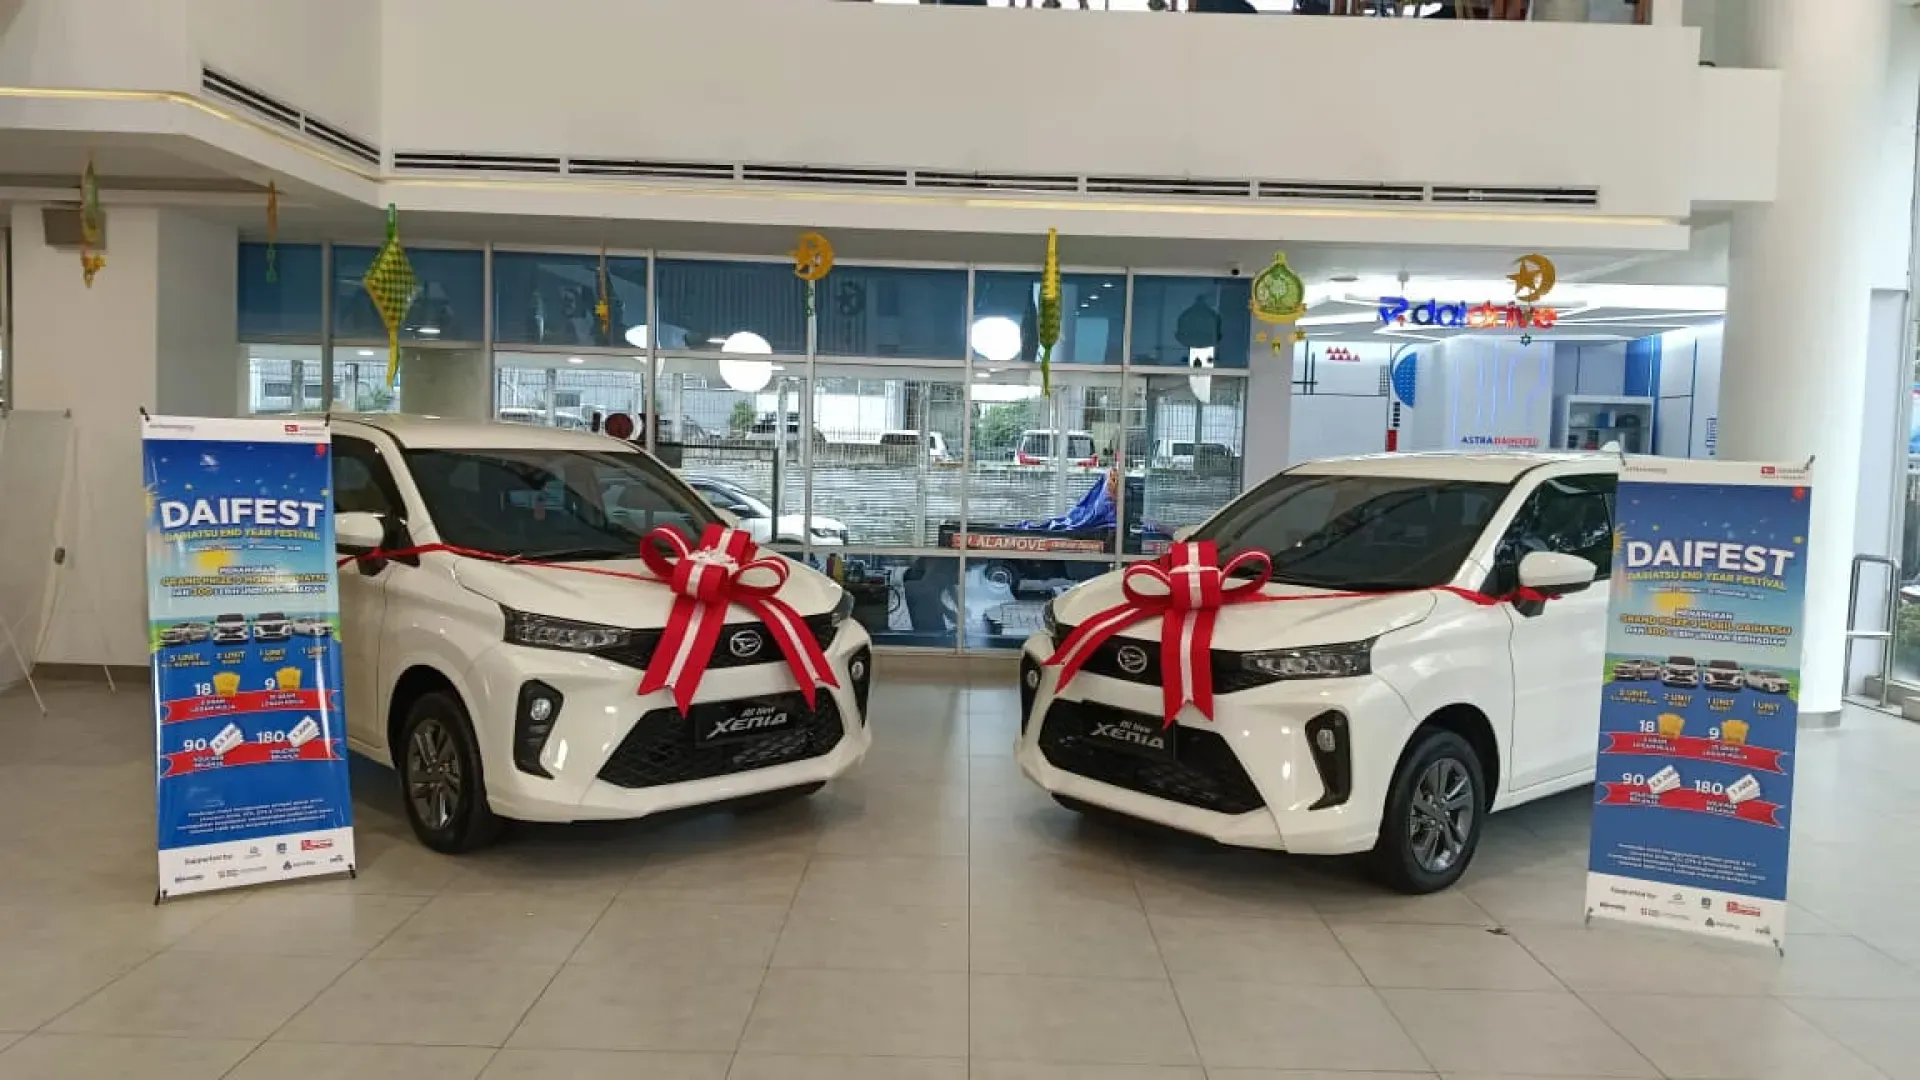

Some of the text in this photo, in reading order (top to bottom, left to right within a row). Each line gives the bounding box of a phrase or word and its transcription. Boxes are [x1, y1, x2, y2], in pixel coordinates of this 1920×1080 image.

[1411, 297, 1558, 329] daidrive
[160, 499, 324, 529] DAIFEST
[220, 528, 241, 537] END
[245, 528, 272, 537] YEAR
[275, 529, 320, 540] FESTIVAL
[1626, 540, 1795, 576] DAIFEST
[1627, 570, 1786, 591] DAIHATSU END YEAR FESTIVAL
[194, 683, 212, 696] 18
[264, 678, 275, 690] 9
[706, 712, 788, 740] XENIA
[1639, 719, 1656, 733] 18
[256, 732, 285, 744] 180
[1090, 722, 1164, 749] XENIA
[1709, 727, 1720, 740] 9
[183, 739, 207, 752] 90
[1622, 773, 1645, 786] 90
[1694, 780, 1724, 796] 180
